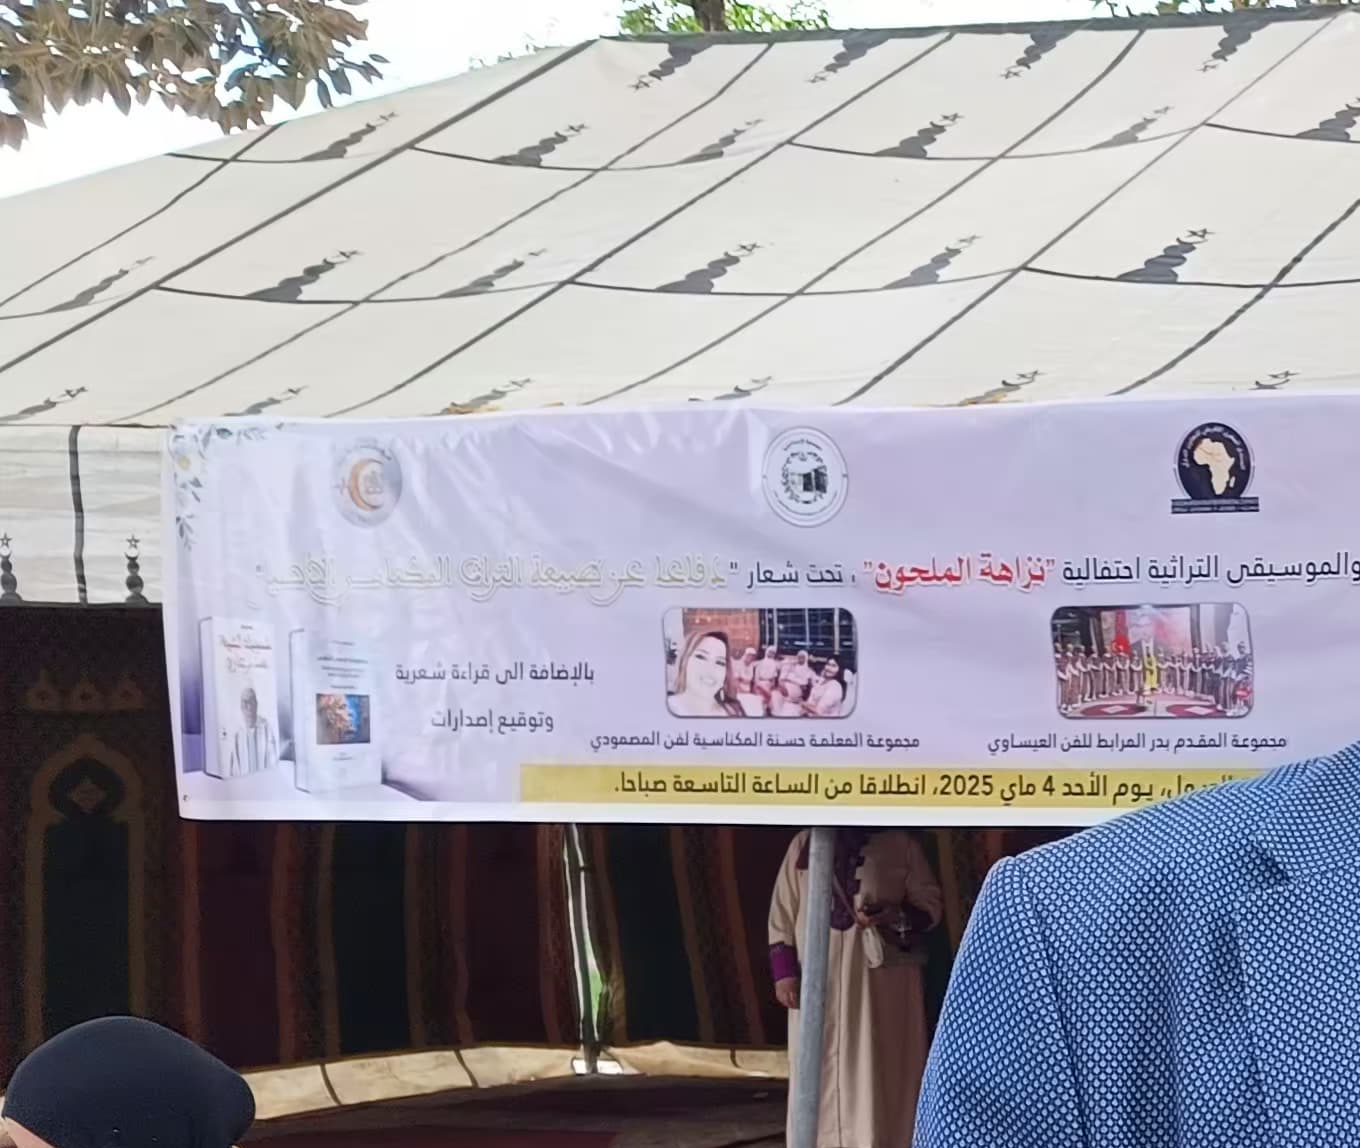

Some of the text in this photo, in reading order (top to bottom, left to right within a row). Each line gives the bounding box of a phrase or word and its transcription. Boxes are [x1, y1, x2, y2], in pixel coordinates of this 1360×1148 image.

[747, 561, 799, 588] شعار
[806, 564, 844, 583] تحت
[1061, 556, 1140, 586] احتفالية
[1146, 555, 1219, 588] التراثية
[395, 661, 447, 685] شعرية
[451, 661, 490, 685] قراءة
[529, 662, 594, 687] بالإضافة
[497, 712, 554, 735] وتوقيع
[590, 731, 660, 752] المصمودي
[663, 731, 689, 750] لفن
[693, 732, 763, 750] المكناسية
[809, 732, 863, 748] المعلمة
[866, 734, 920, 752] مجموعة
[987, 732, 1288, 755] مجموعة المقدم بدر المرابط للفن العيساوي
[673, 772, 746, 793] التاسعة
[752, 773, 819, 794] الساعة
[824, 779, 852, 800] من
[860, 774, 925, 795] انطلاقا
[1000, 774, 1036, 806] ماي
[1042, 775, 1056, 796] 4
[1062, 773, 1107, 796] الأحد
[1112, 783, 1154, 806] يوم
